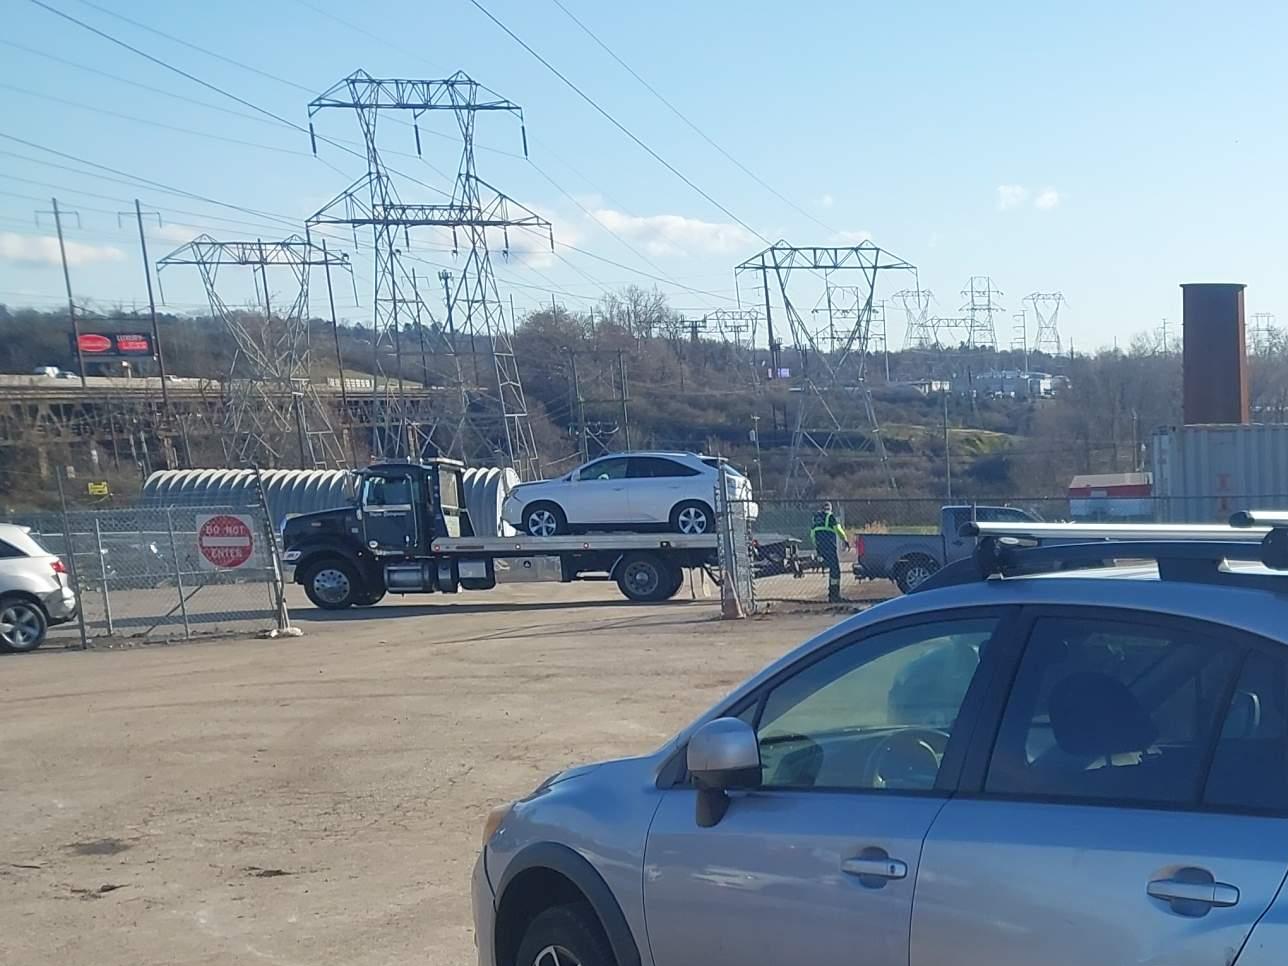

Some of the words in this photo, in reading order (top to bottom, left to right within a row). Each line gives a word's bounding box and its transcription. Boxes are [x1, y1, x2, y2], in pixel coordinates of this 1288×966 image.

[206, 525, 220, 535] DO
[225, 525, 247, 535] NOT
[210, 549, 243, 558] ENTER
